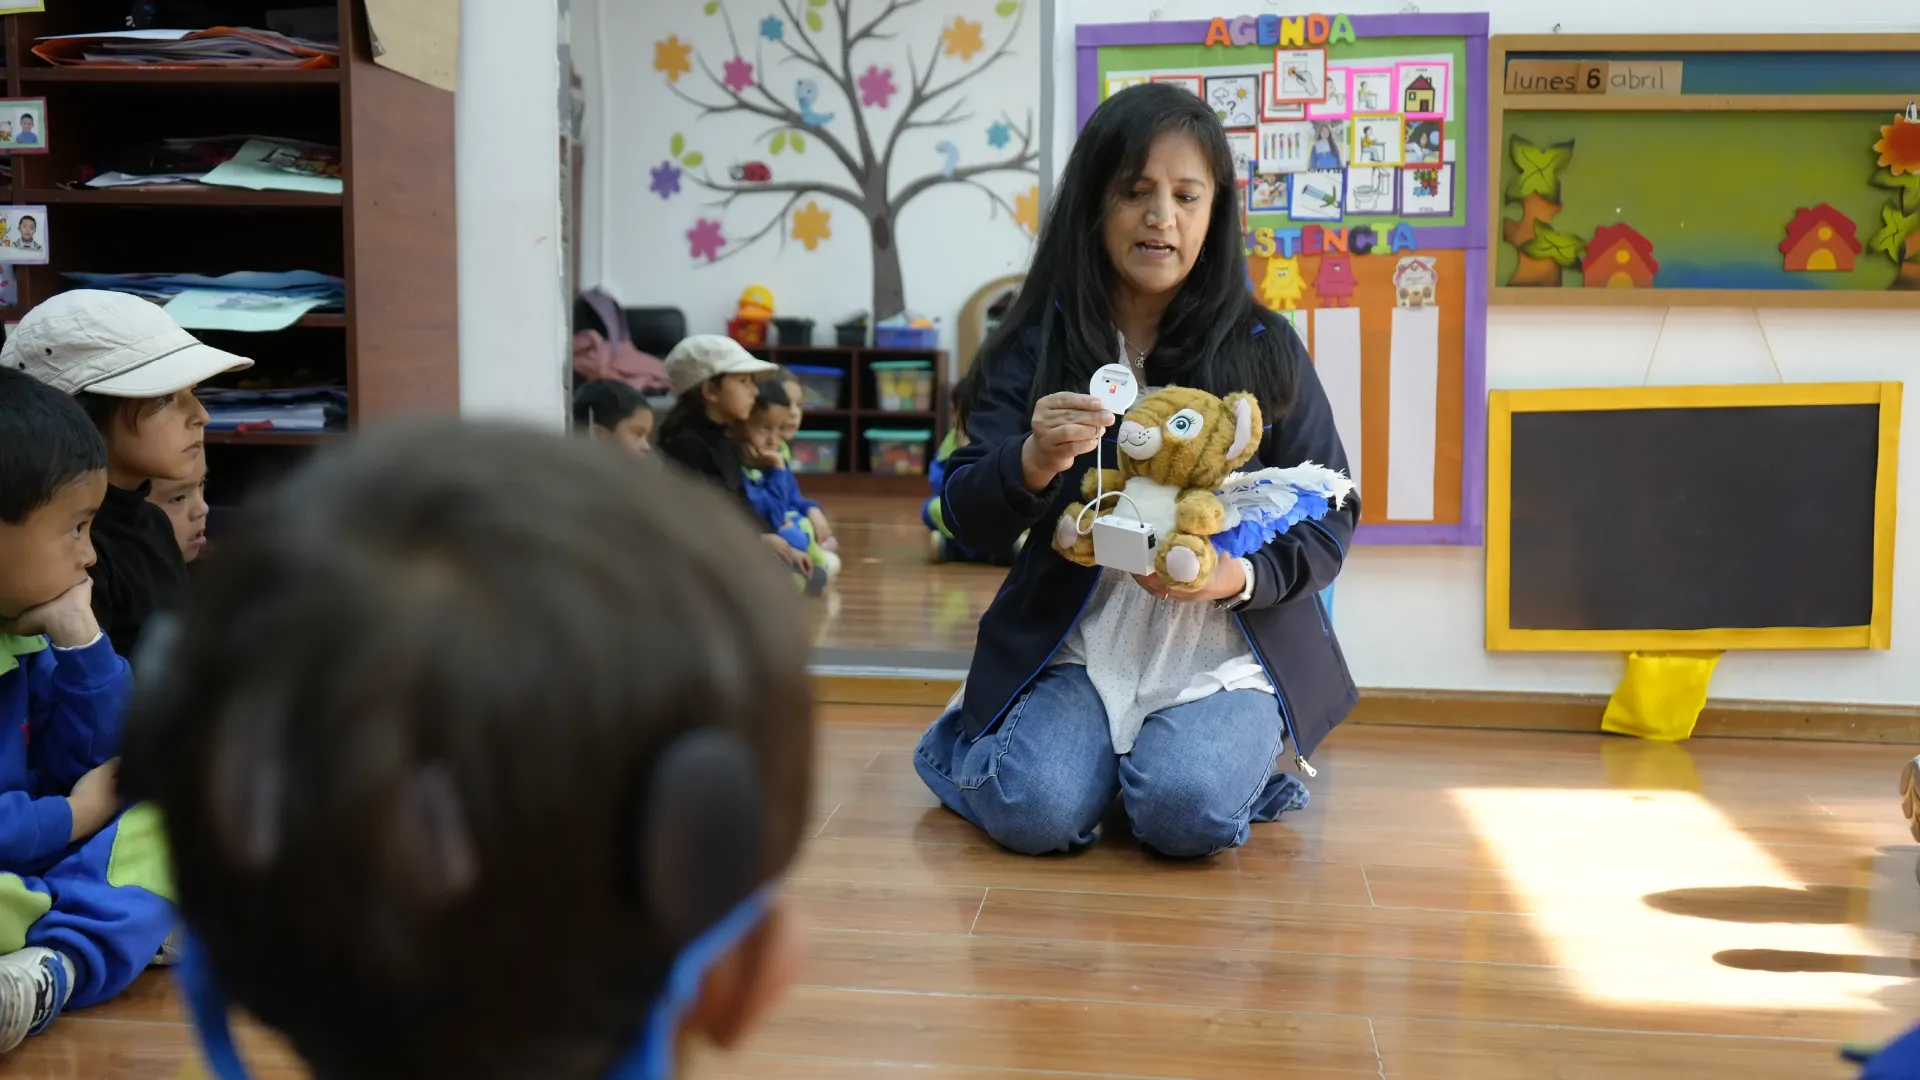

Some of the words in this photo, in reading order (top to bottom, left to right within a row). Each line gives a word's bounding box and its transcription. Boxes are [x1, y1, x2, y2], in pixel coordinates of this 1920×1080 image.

[1205, 13, 1356, 46] AGENDA
[1513, 71, 1575, 91] lunes
[1586, 68, 1601, 90] 6
[1610, 66, 1664, 90] abril
